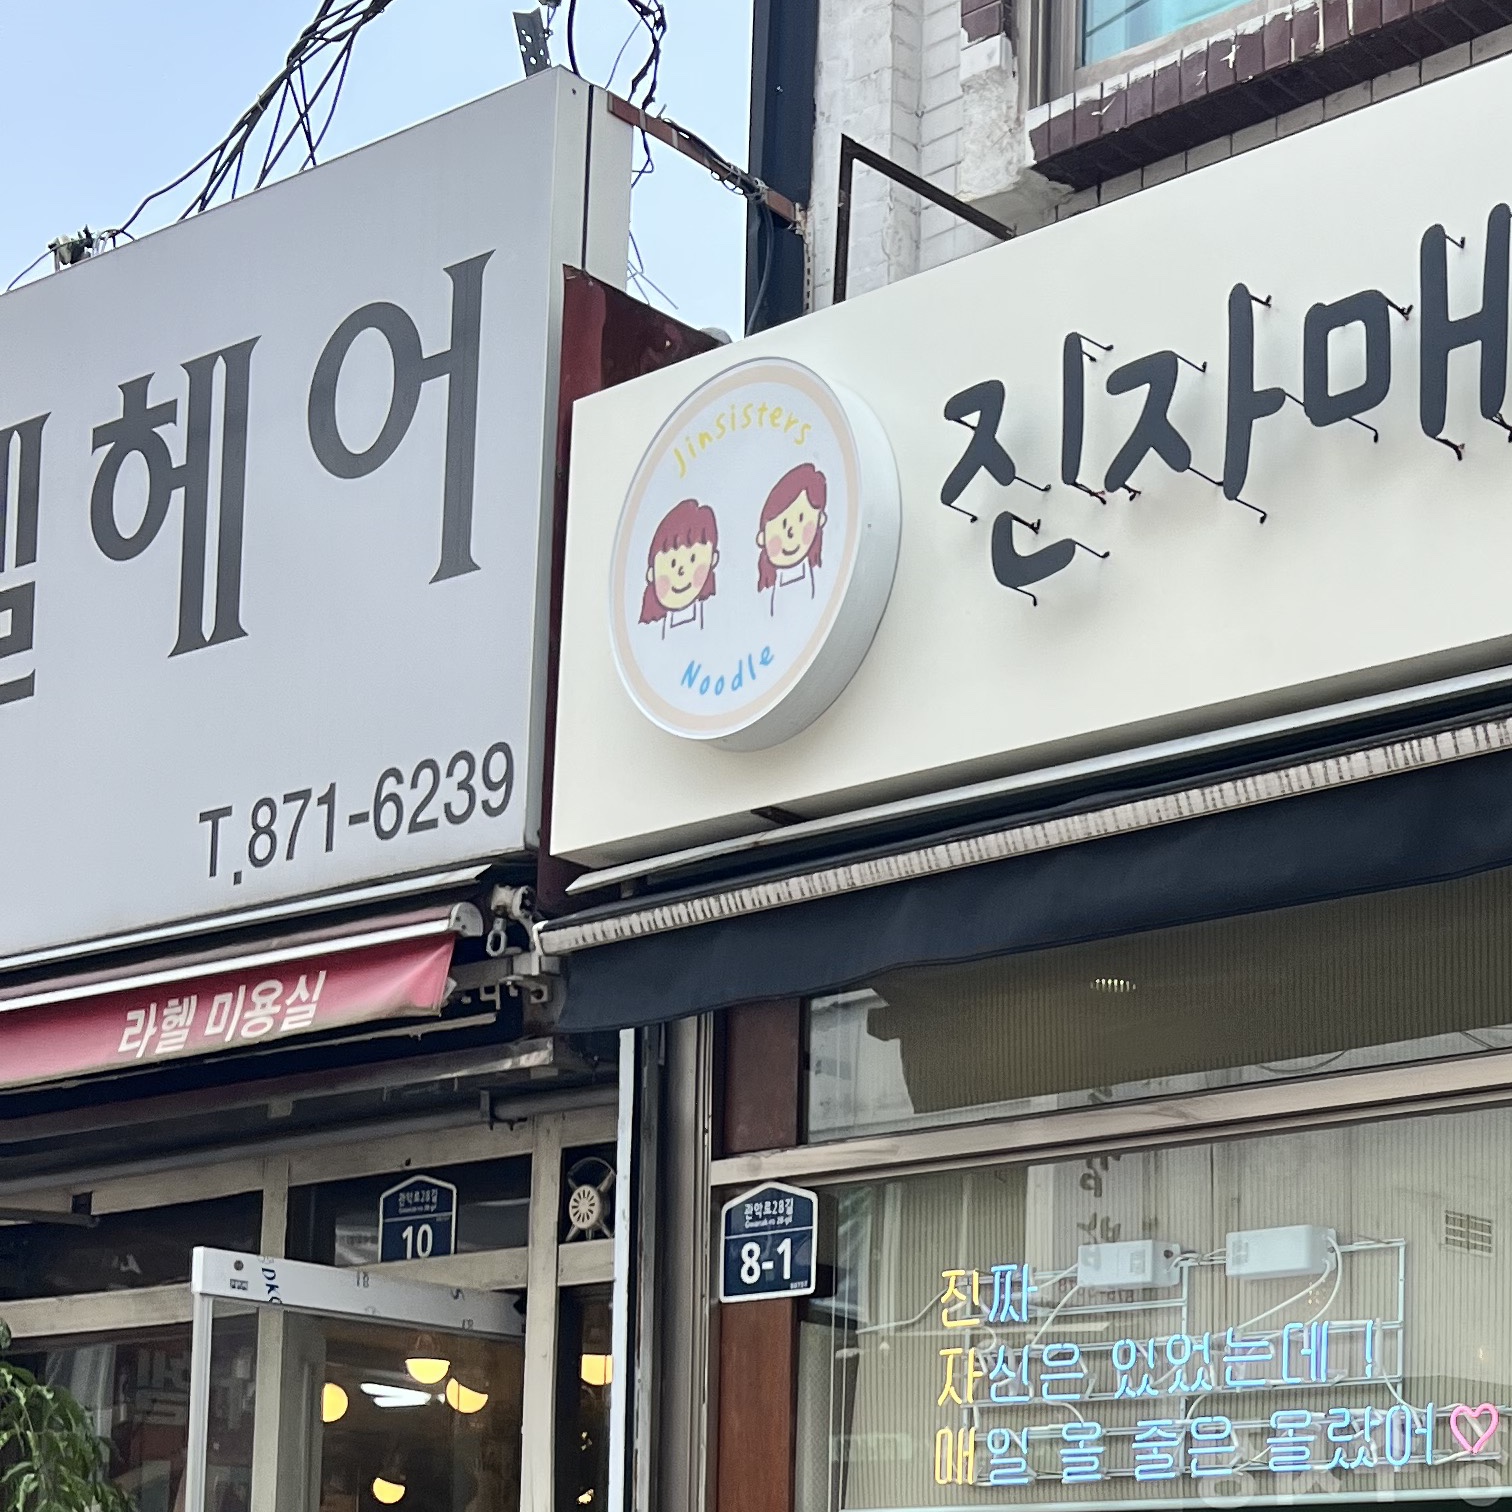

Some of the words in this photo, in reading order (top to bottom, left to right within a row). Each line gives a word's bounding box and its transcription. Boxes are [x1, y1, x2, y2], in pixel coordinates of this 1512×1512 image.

[940, 203, 1511, 587] 진자매
[681, 644, 775, 696] Noodle
[199, 741, 516, 885] T.871-6239
[118, 998, 197, 1058] 라헬
[204, 970, 327, 1043] 미용실
[401, 1223, 433, 1260] 10
[740, 1237, 792, 1285] 8-1
[940, 1263, 1039, 1329] 진짜
[937, 1344, 1085, 1407] 자신은
[934, 1424, 1031, 1486] 매일
